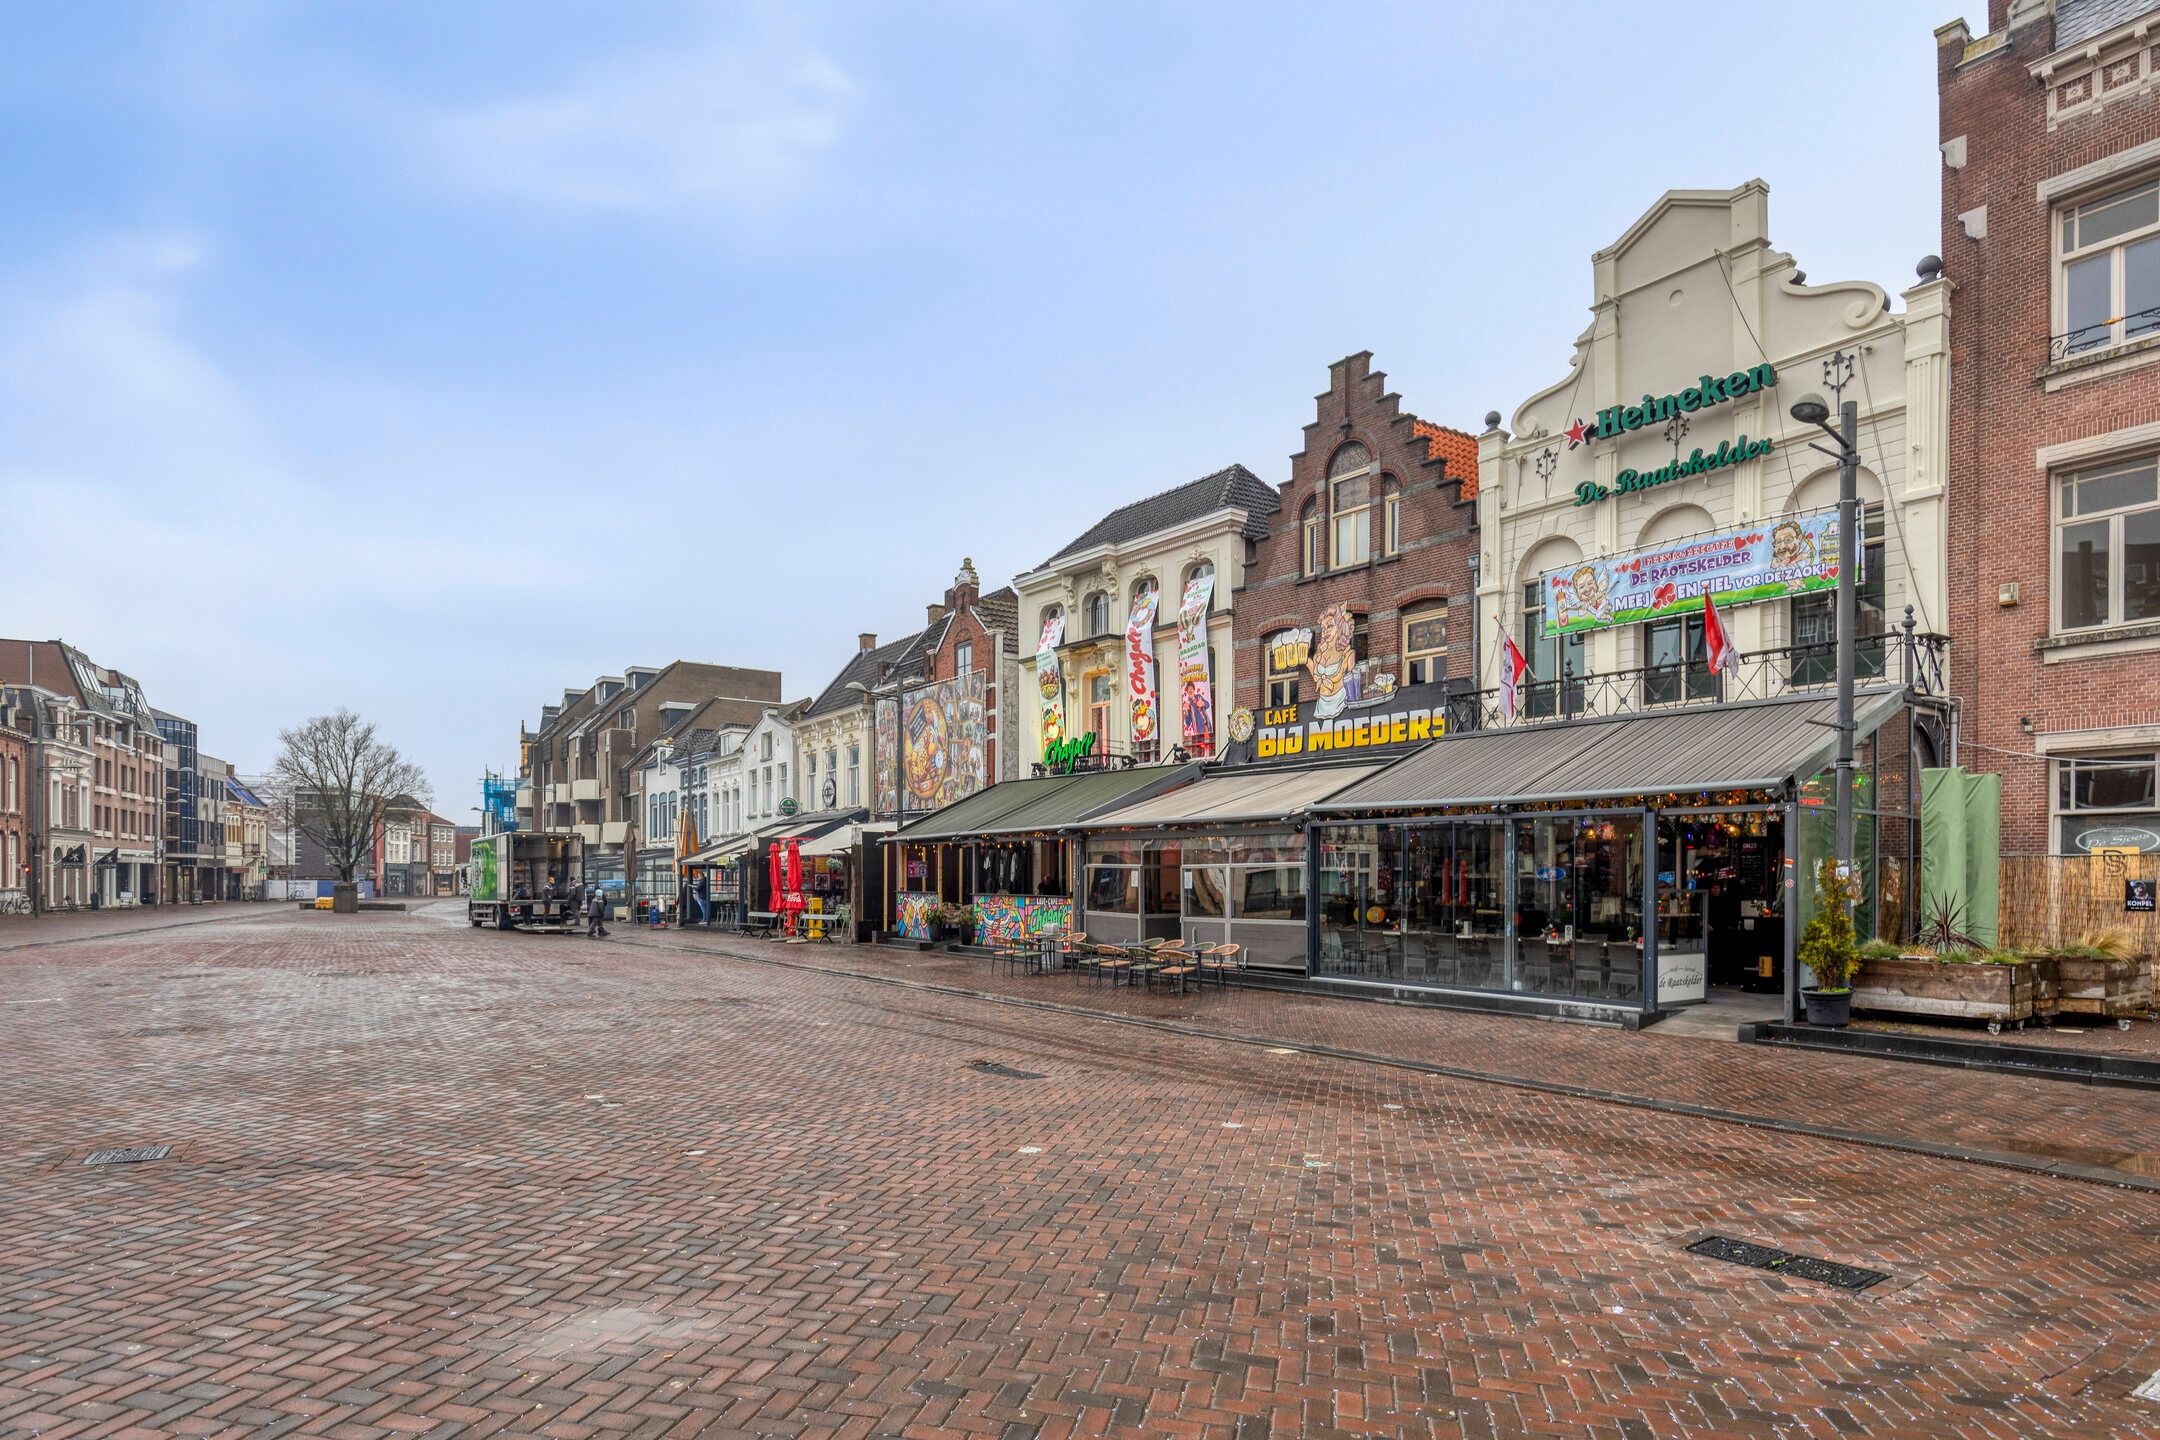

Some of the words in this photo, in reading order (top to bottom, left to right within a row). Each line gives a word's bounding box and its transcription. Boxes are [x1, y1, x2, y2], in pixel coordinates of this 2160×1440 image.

[1596, 363, 1776, 440] Heineken
[1573, 480, 1608, 506] De
[1608, 434, 1776, 497] Raatskelder
[1631, 571, 1648, 587] DE
[1651, 551, 1752, 582] RAOTSKELDER
[1613, 591, 1650, 612] MEEJ
[1676, 582, 1698, 600] EN
[1700, 575, 1733, 596] ZIEL
[1735, 573, 1762, 589] VOR
[1764, 570, 1781, 583] DE
[1258, 726, 1303, 758] BIJ
[1308, 706, 1445, 752] MOEDERS
[1265, 704, 1298, 726] CAFÉ
[1044, 731, 1096, 774] Chagall
